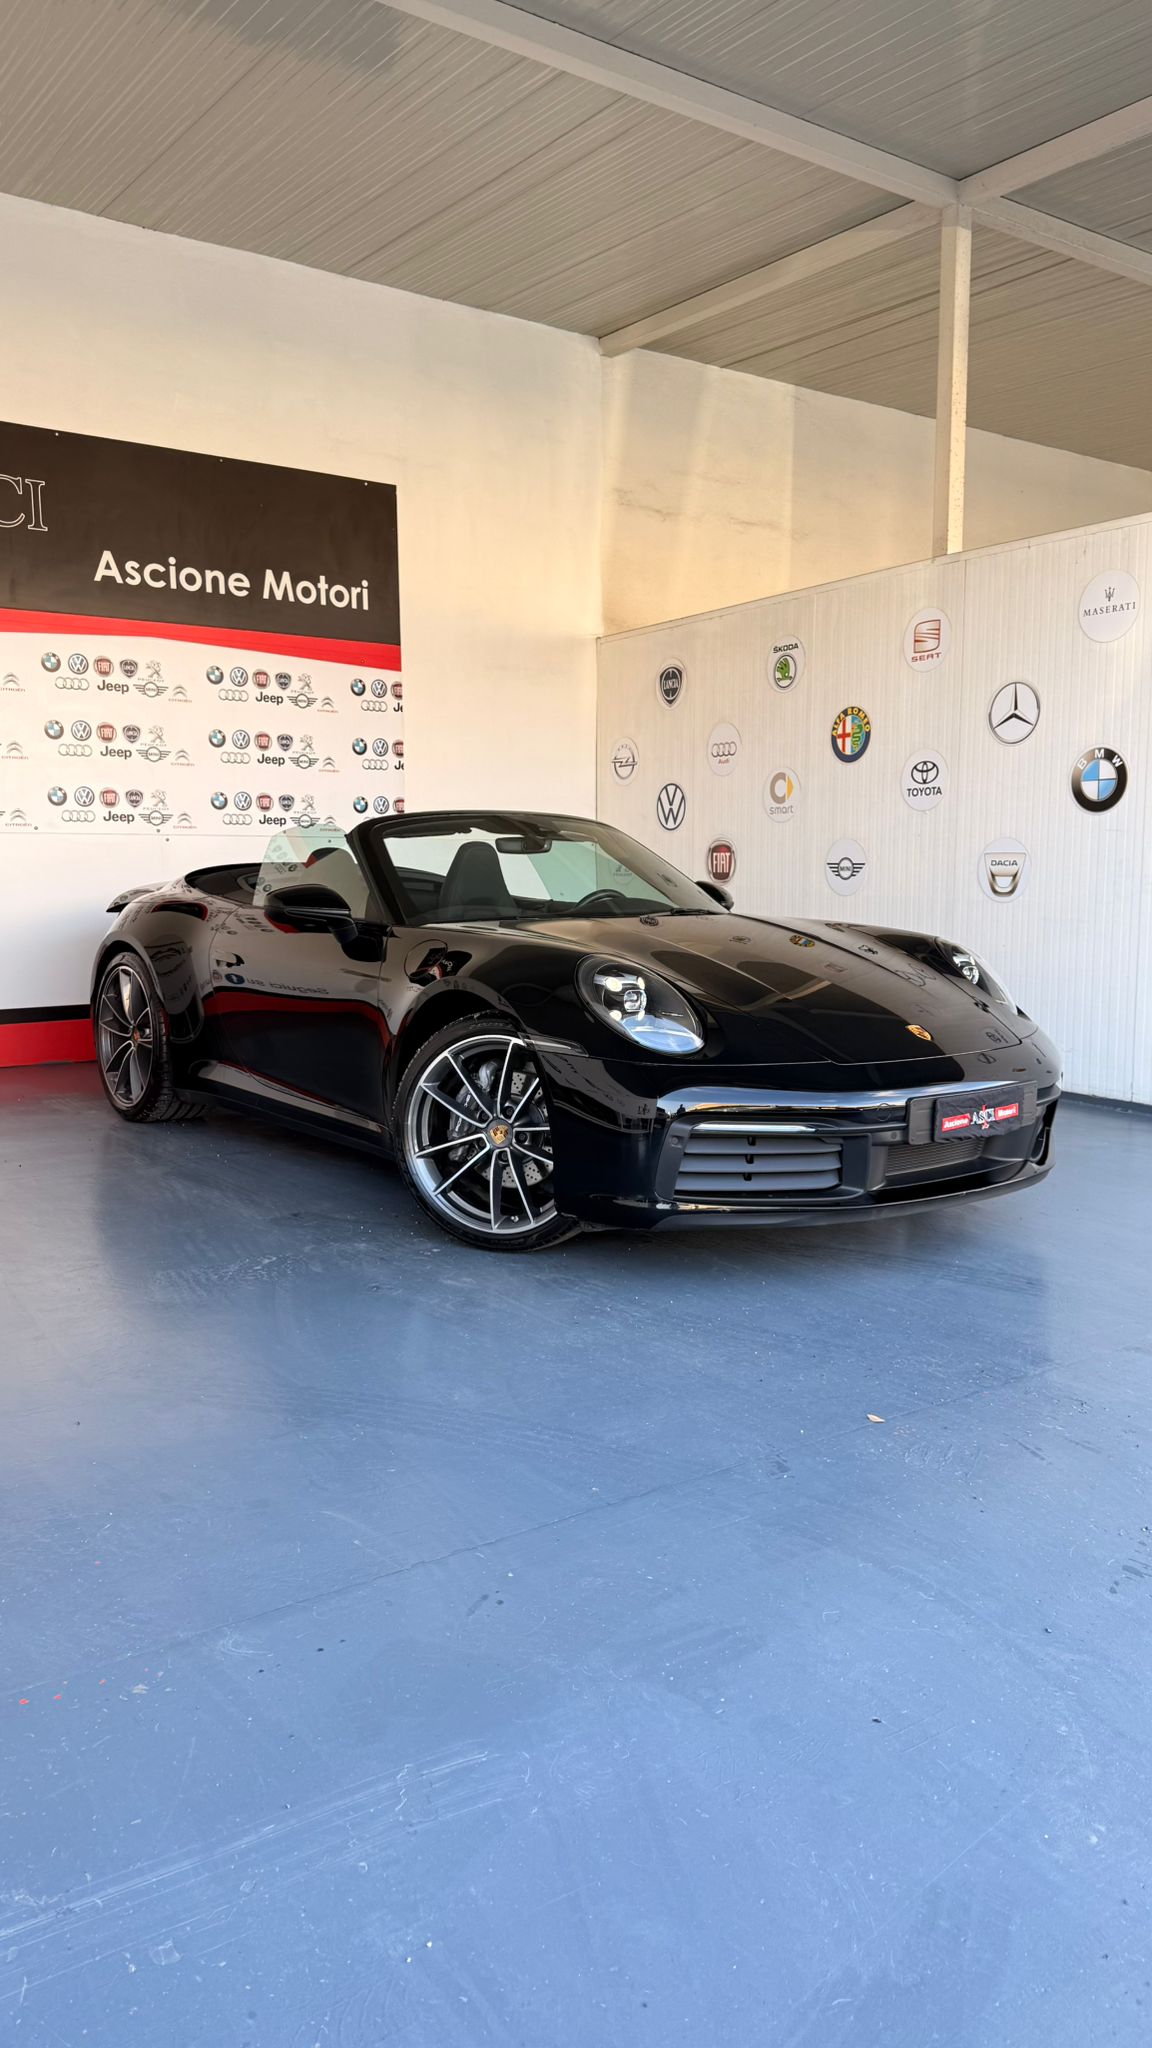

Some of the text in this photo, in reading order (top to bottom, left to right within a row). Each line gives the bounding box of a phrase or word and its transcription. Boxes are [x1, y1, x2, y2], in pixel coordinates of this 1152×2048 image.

[94, 550, 369, 610] Ascione Motori
[1082, 602, 1136, 617] MASERATI
[773, 642, 799, 653] ŠKODA
[911, 652, 942, 663] SEAT
[97, 680, 129, 694] Jeep
[255, 691, 284, 705] Jeep
[832, 707, 871, 736] ALFA ROMEO
[100, 746, 132, 760] Jeep
[1077, 748, 1123, 770] BMW
[257, 754, 285, 767] Jeep
[906, 787, 942, 797] TOYOTA
[769, 805, 794, 815] smart
[103, 811, 135, 824] Jeep
[259, 814, 287, 827] Jeep
[712, 852, 731, 874] FIAT
[990, 859, 1018, 867] DACIA
